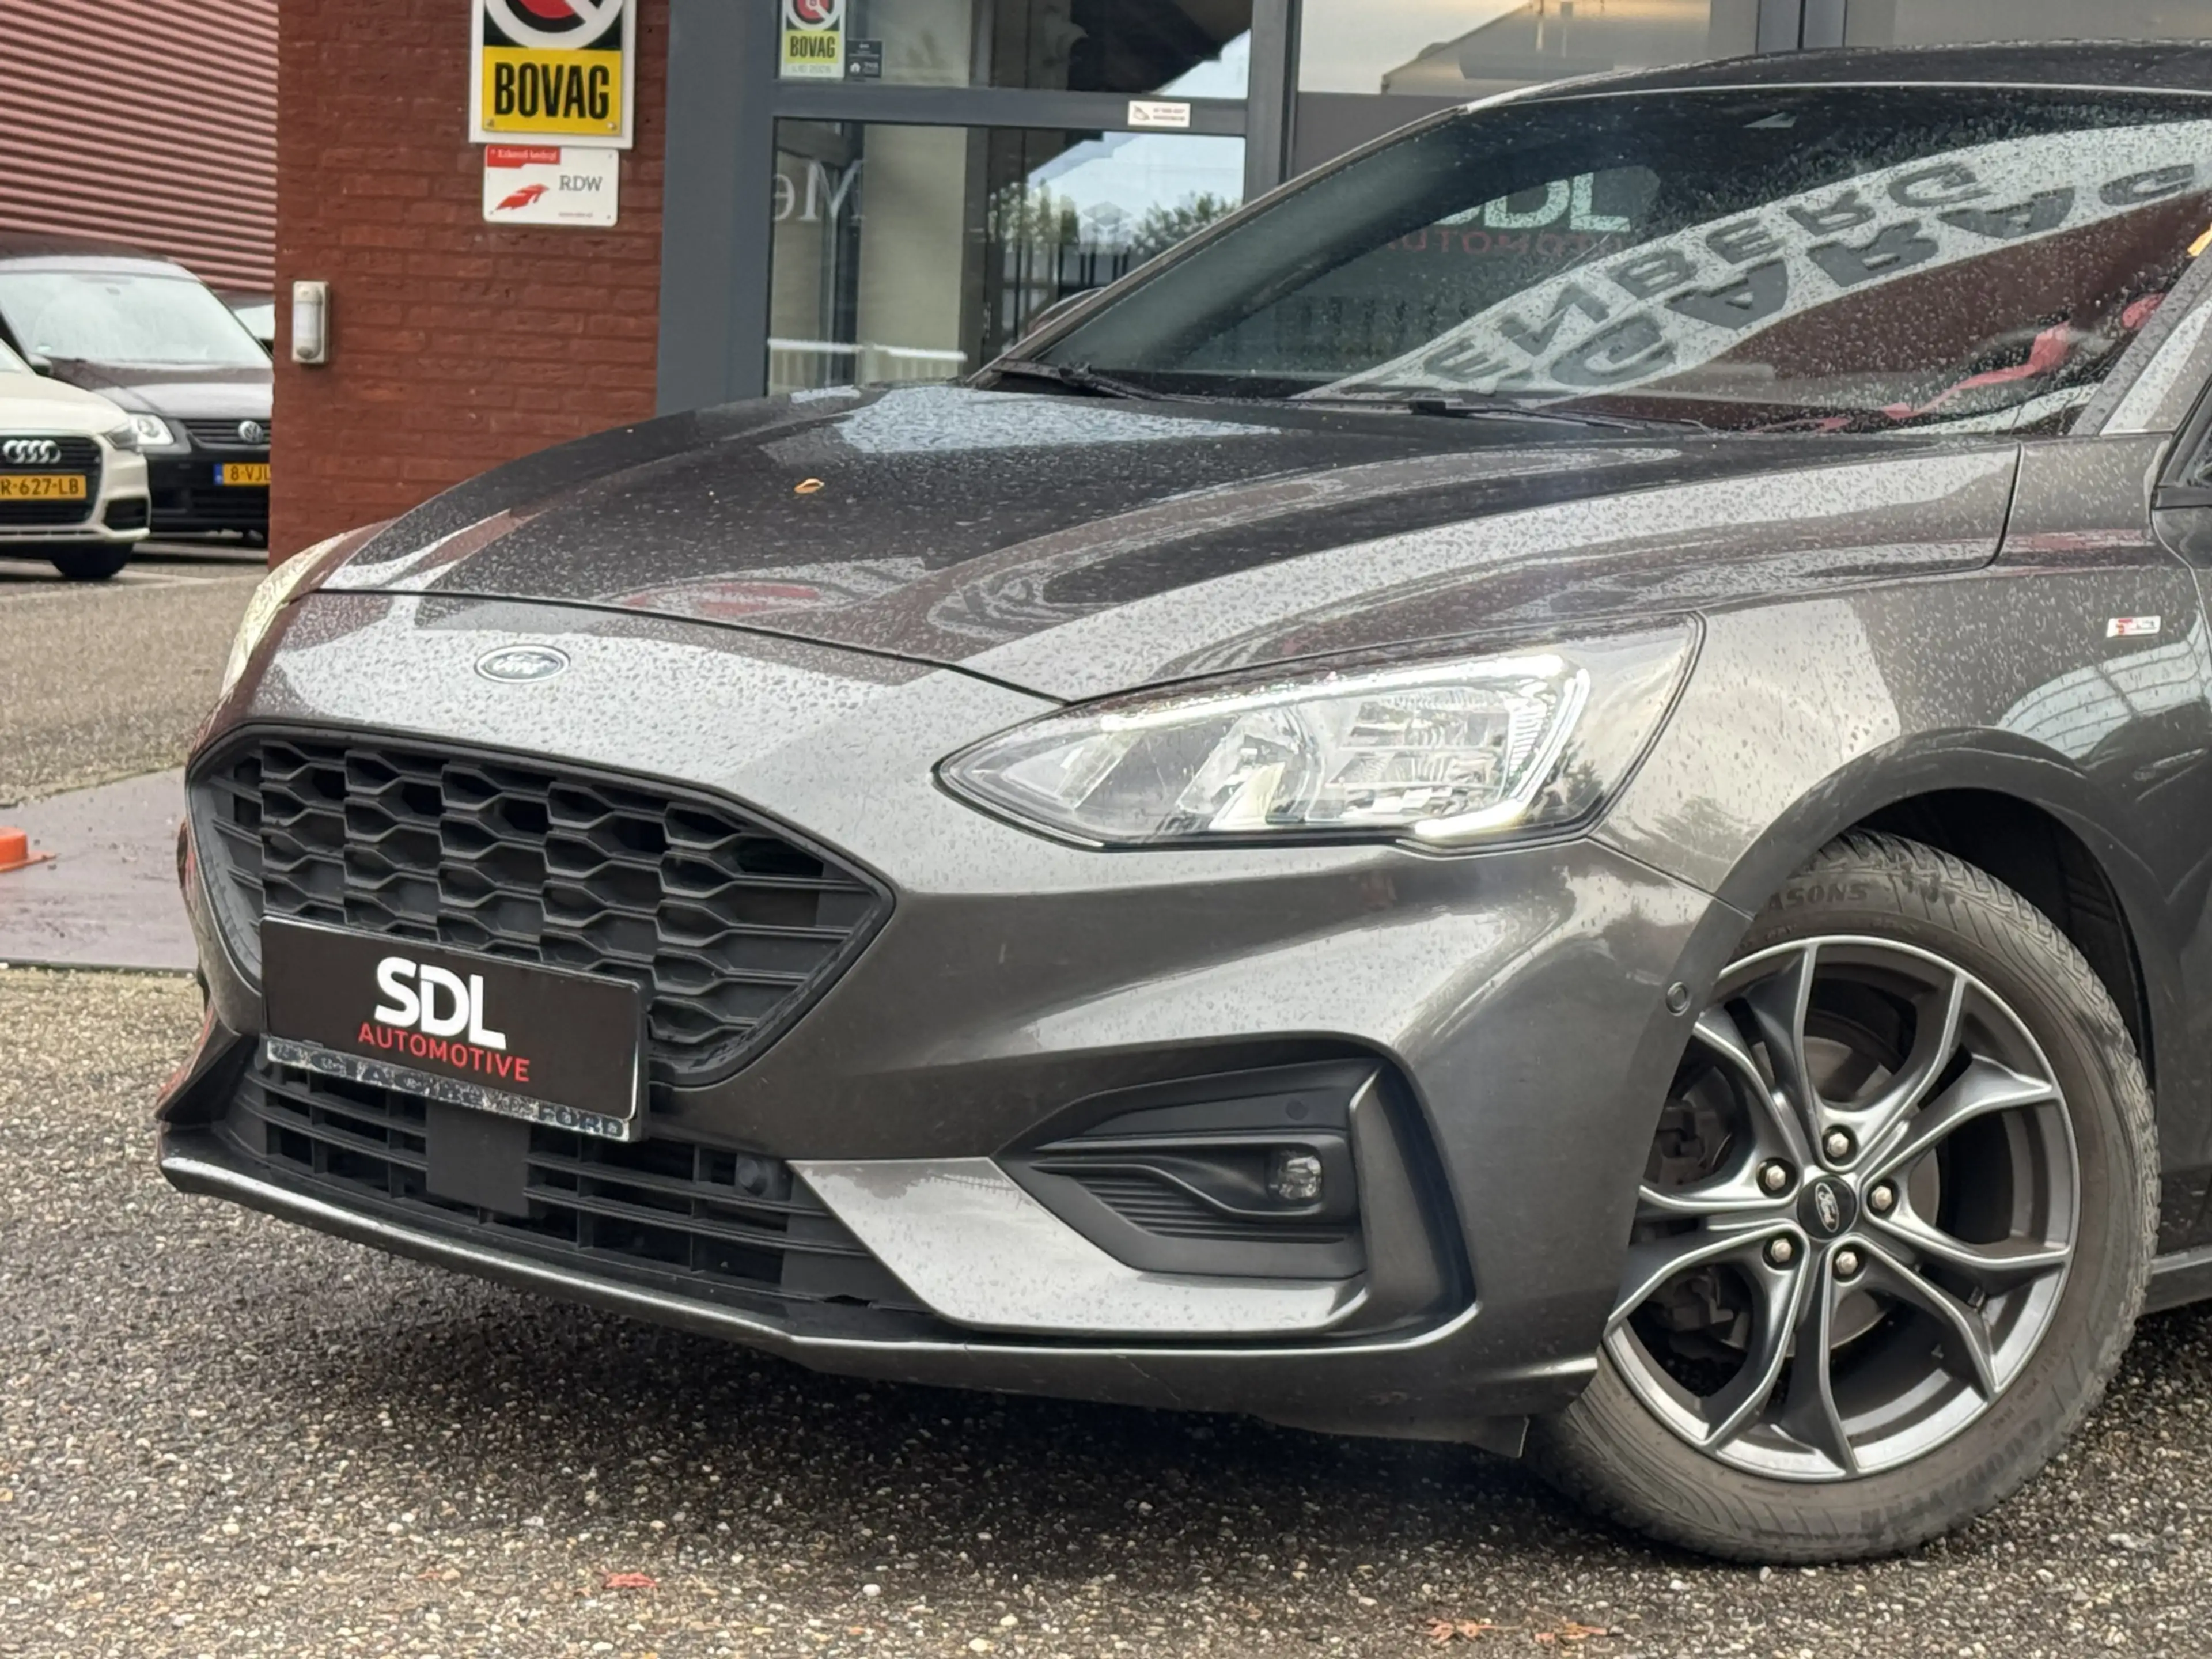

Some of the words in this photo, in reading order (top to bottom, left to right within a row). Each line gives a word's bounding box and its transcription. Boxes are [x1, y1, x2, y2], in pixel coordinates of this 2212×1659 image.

[790, 35, 836, 58] BOVAG
[494, 62, 610, 119] BOVAG
[559, 175, 603, 192] RDW
[1433, 172, 1631, 232] DL
[374, 956, 507, 1050] SDL
[358, 1022, 530, 1082] AUTOMOTIVE
